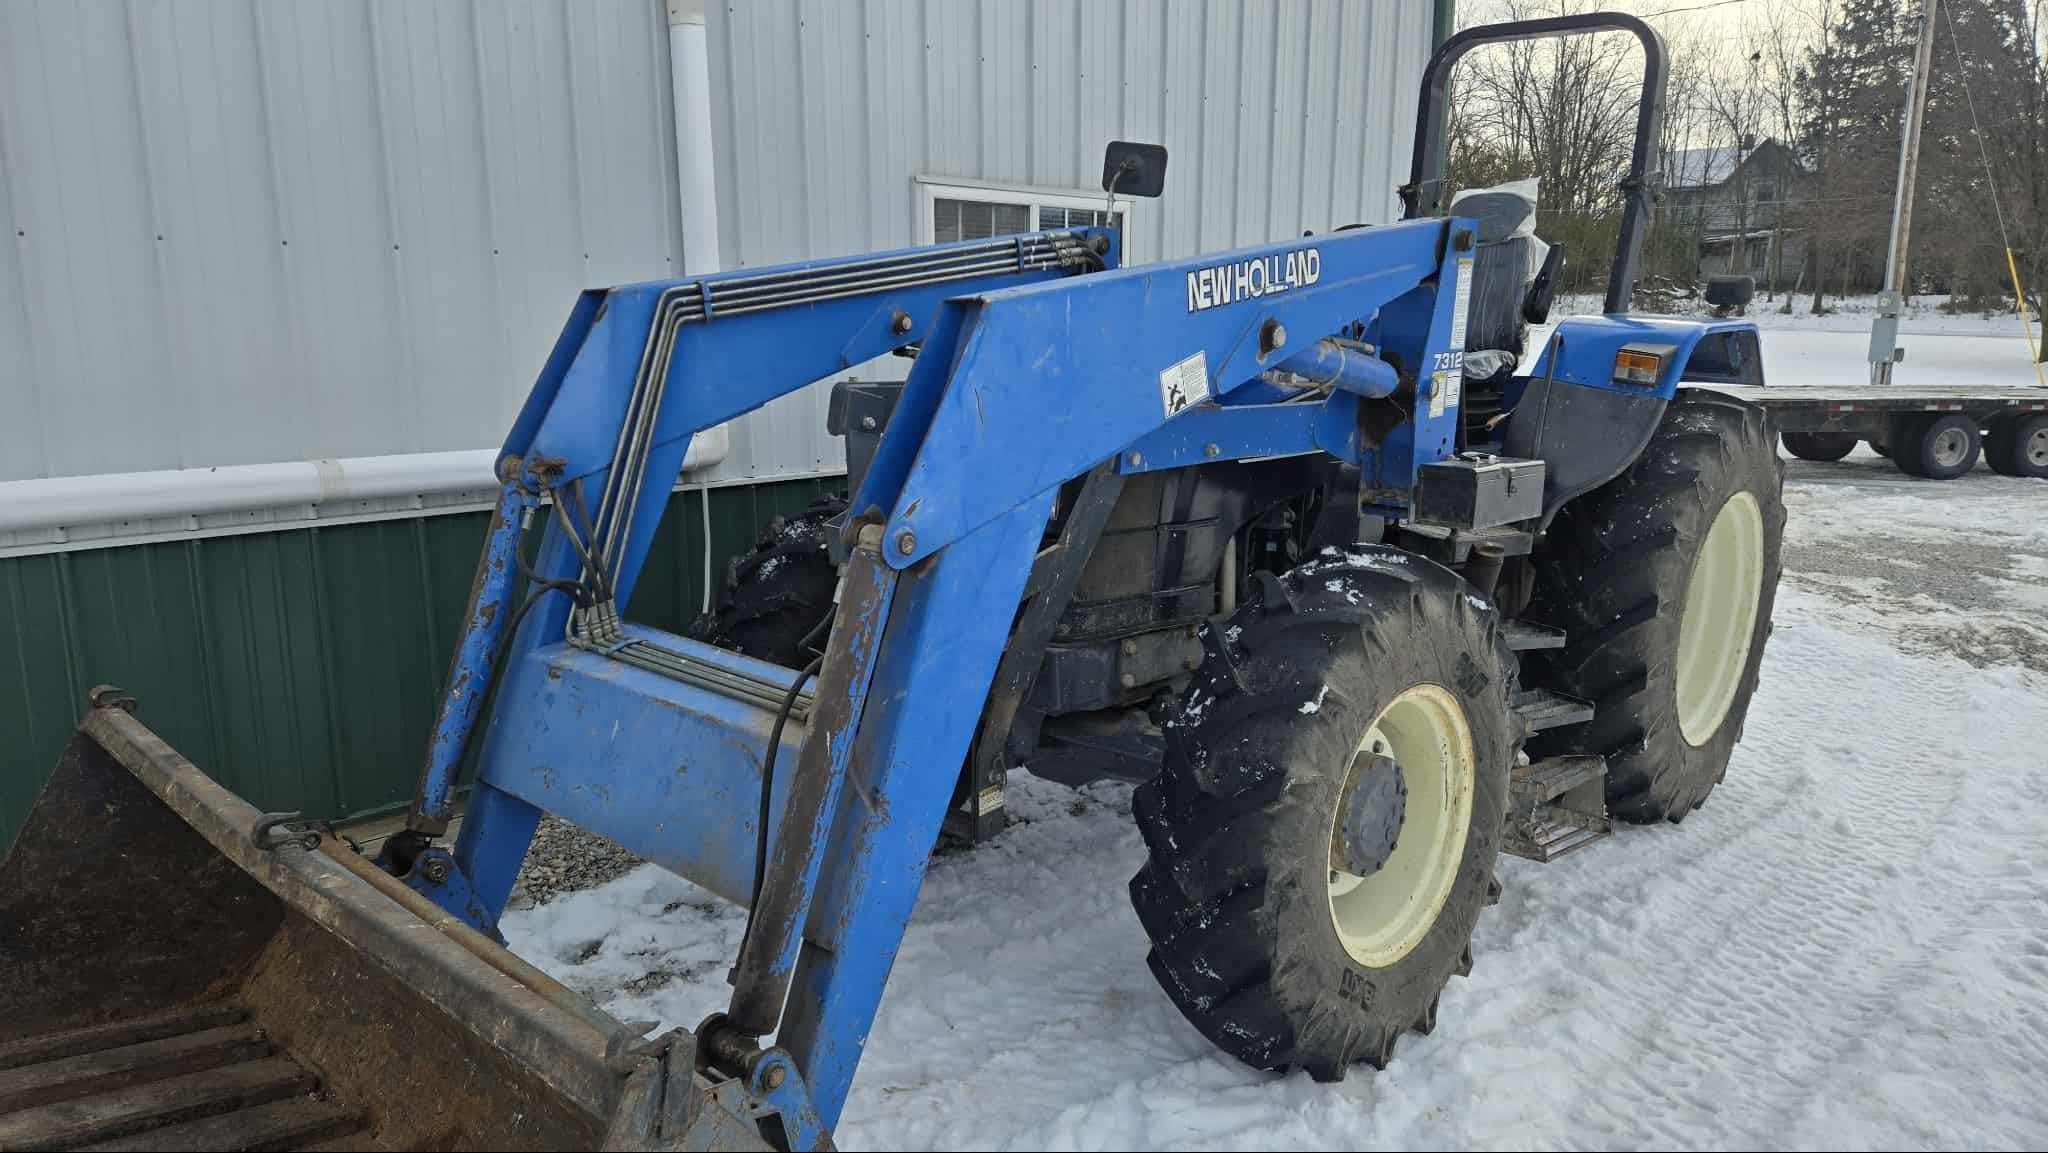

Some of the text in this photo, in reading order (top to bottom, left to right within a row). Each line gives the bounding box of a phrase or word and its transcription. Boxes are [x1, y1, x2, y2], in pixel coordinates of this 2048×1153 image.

[1187, 248, 1320, 313] NEW HOLLAND
[1433, 352, 1463, 370] 7312
